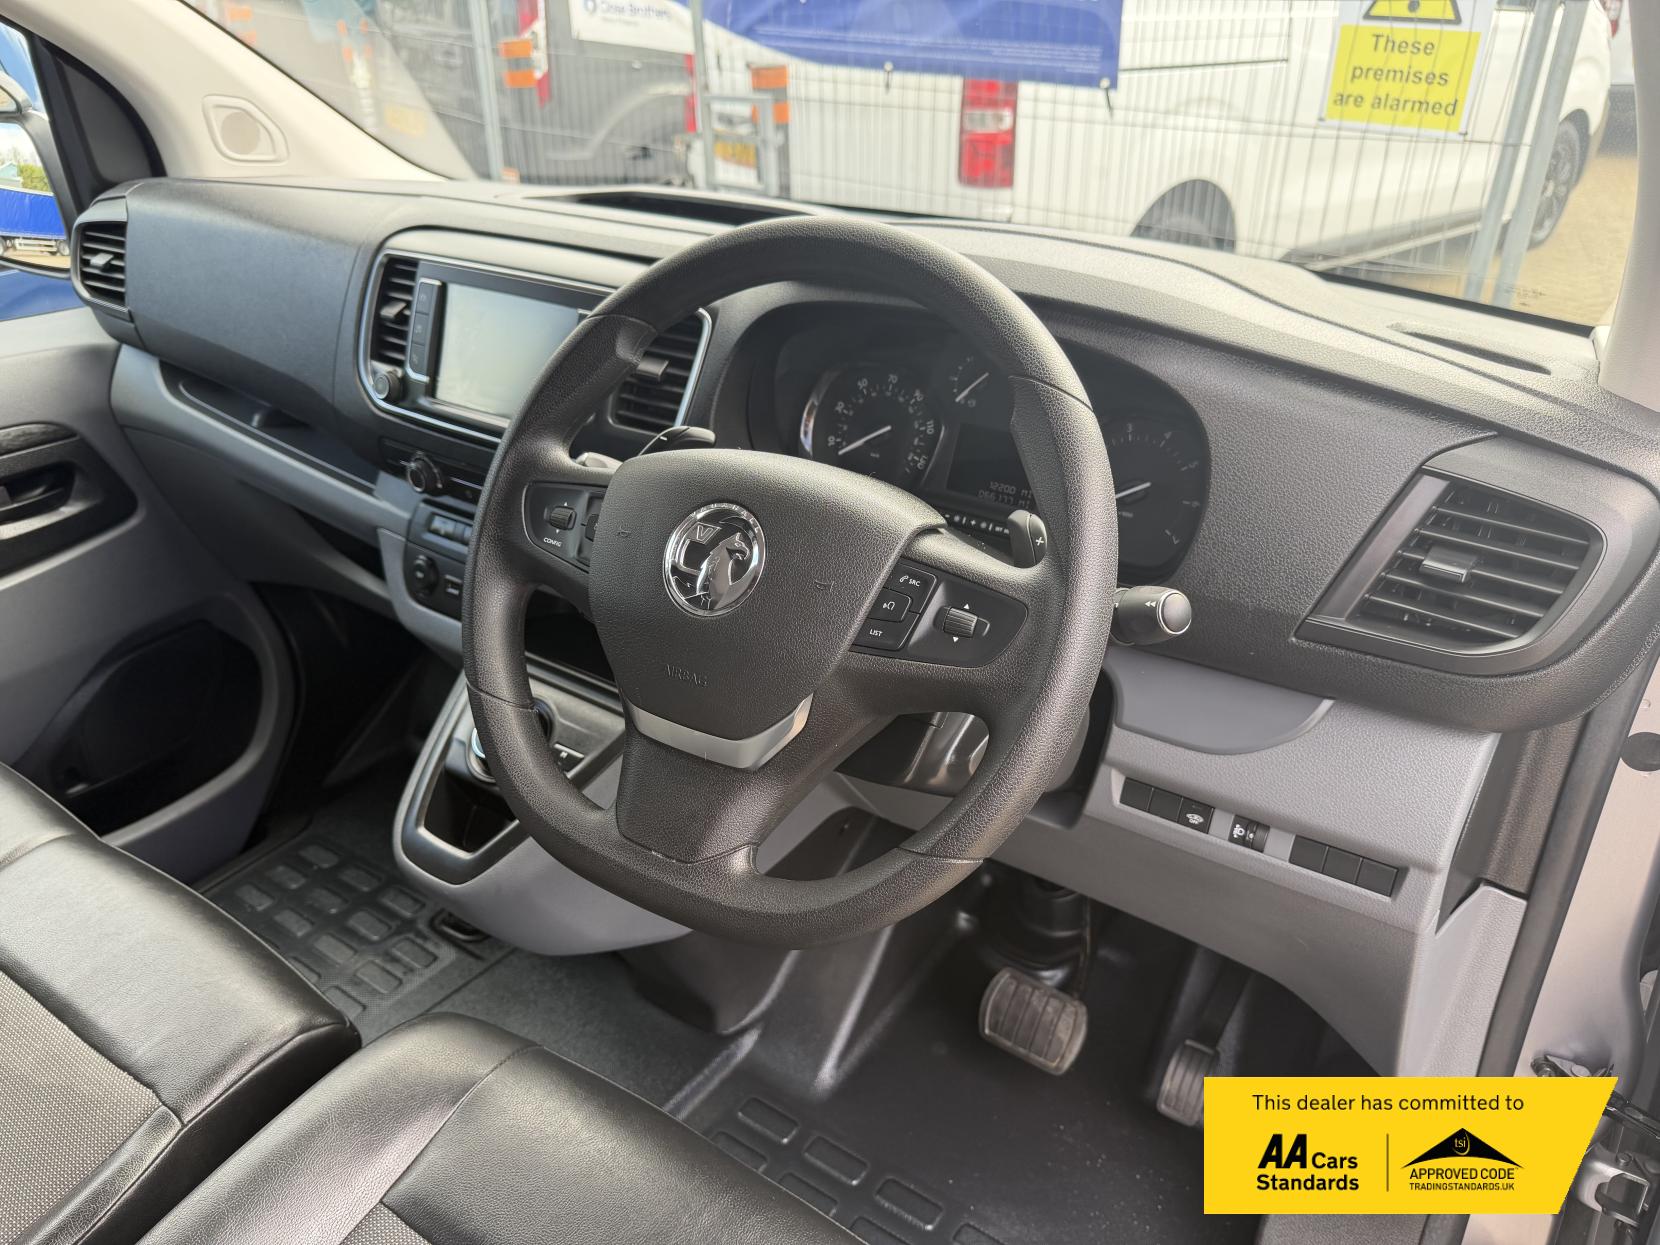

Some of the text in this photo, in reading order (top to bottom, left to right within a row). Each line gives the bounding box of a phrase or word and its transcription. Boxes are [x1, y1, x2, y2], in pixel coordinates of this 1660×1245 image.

[1372, 33, 1435, 56] These
[1350, 65, 1449, 87] premises
[1333, 92, 1458, 116] are alarmed
[543, 537, 562, 548] CONFIG
[908, 578, 921, 588] SRC
[869, 628, 883, 637] LIST
